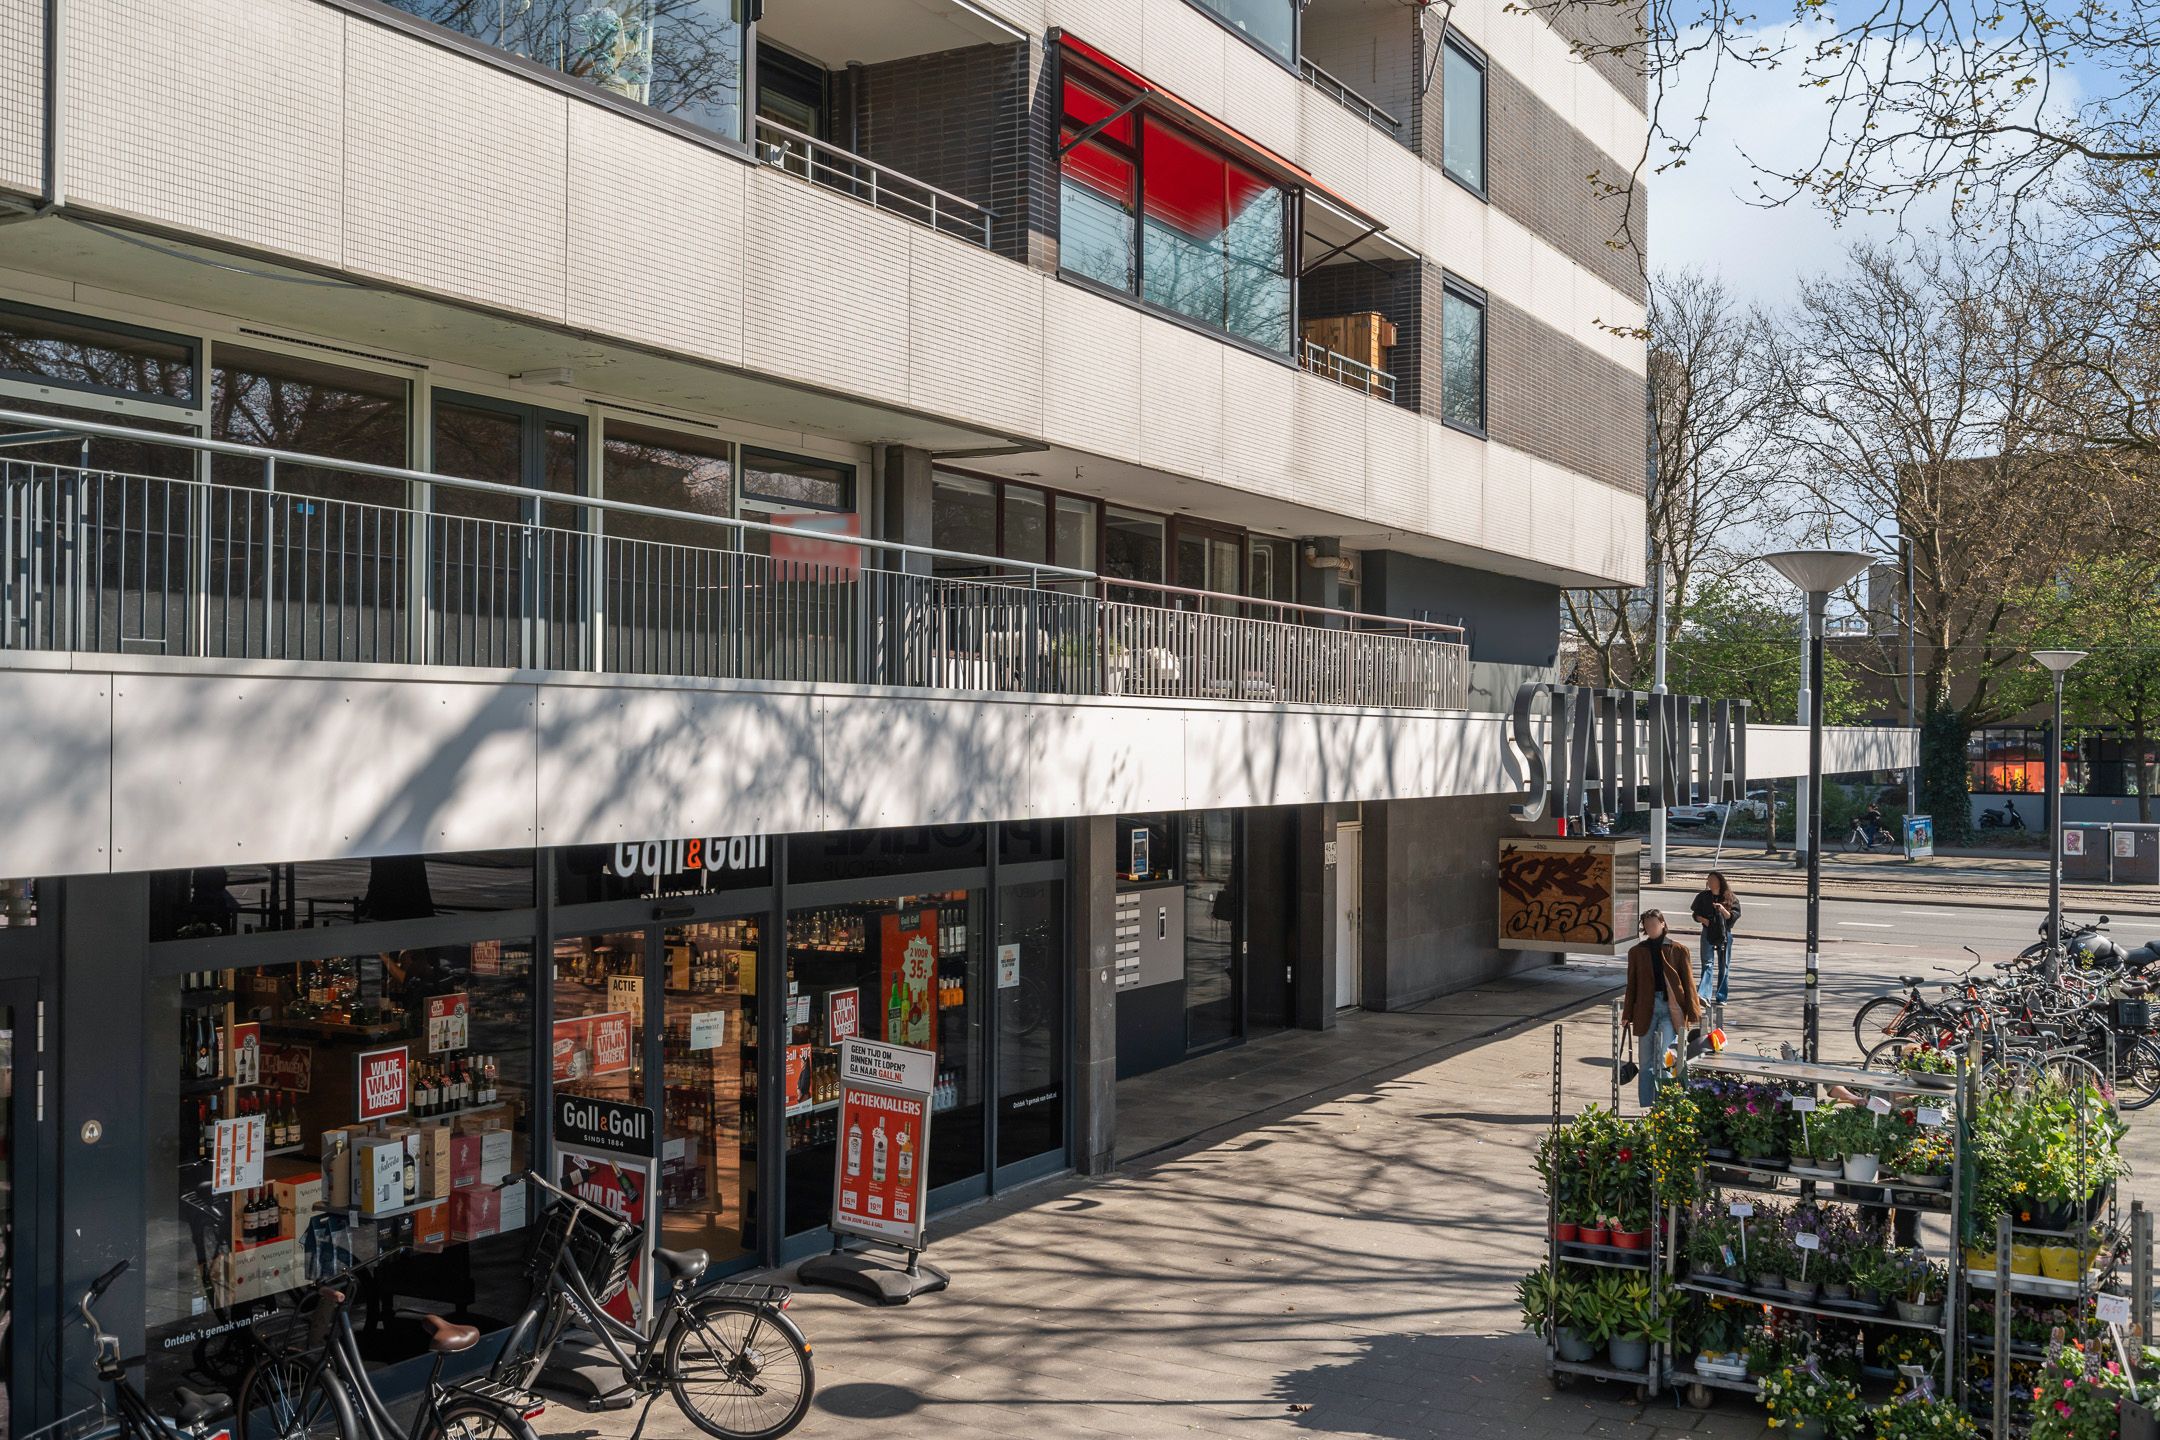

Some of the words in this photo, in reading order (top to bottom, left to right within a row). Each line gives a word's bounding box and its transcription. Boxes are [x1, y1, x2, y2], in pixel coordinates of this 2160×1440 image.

[613, 980, 635, 992] ACTIE
[836, 997, 854, 1010] WILDE
[835, 1006, 855, 1025] WIJN
[601, 1020, 625, 1035] WILDE
[598, 1029, 626, 1054] WIJN
[600, 1049, 625, 1065] DAGEN
[851, 1045, 866, 1056] GEEN
[867, 1048, 881, 1057] TIJD
[882, 1051, 892, 1060] OM
[370, 1058, 400, 1076] WILDE
[850, 1063, 859, 1073] GA
[860, 1066, 877, 1076] NAAR
[878, 1070, 903, 1081] GALL.NL
[851, 1054, 873, 1067] BINNEN
[874, 1058, 881, 1068] TE
[882, 1061, 906, 1072] LOPEN?
[367, 1071, 401, 1096] WIJN
[368, 1091, 400, 1110] DAGEN
[848, 1090, 921, 1116] ACTIEKNALLERS
[563, 1101, 646, 1140] Gall&Gall
[583, 1134, 605, 1144] SINDS
[607, 1138, 624, 1148] 1884
[577, 1181, 628, 1216] WILDE
[561, 1291, 592, 1325] CROWN
[164, 1331, 196, 1349] Ontdek
[205, 1320, 235, 1339] gemak
[236, 1317, 251, 1328] van
